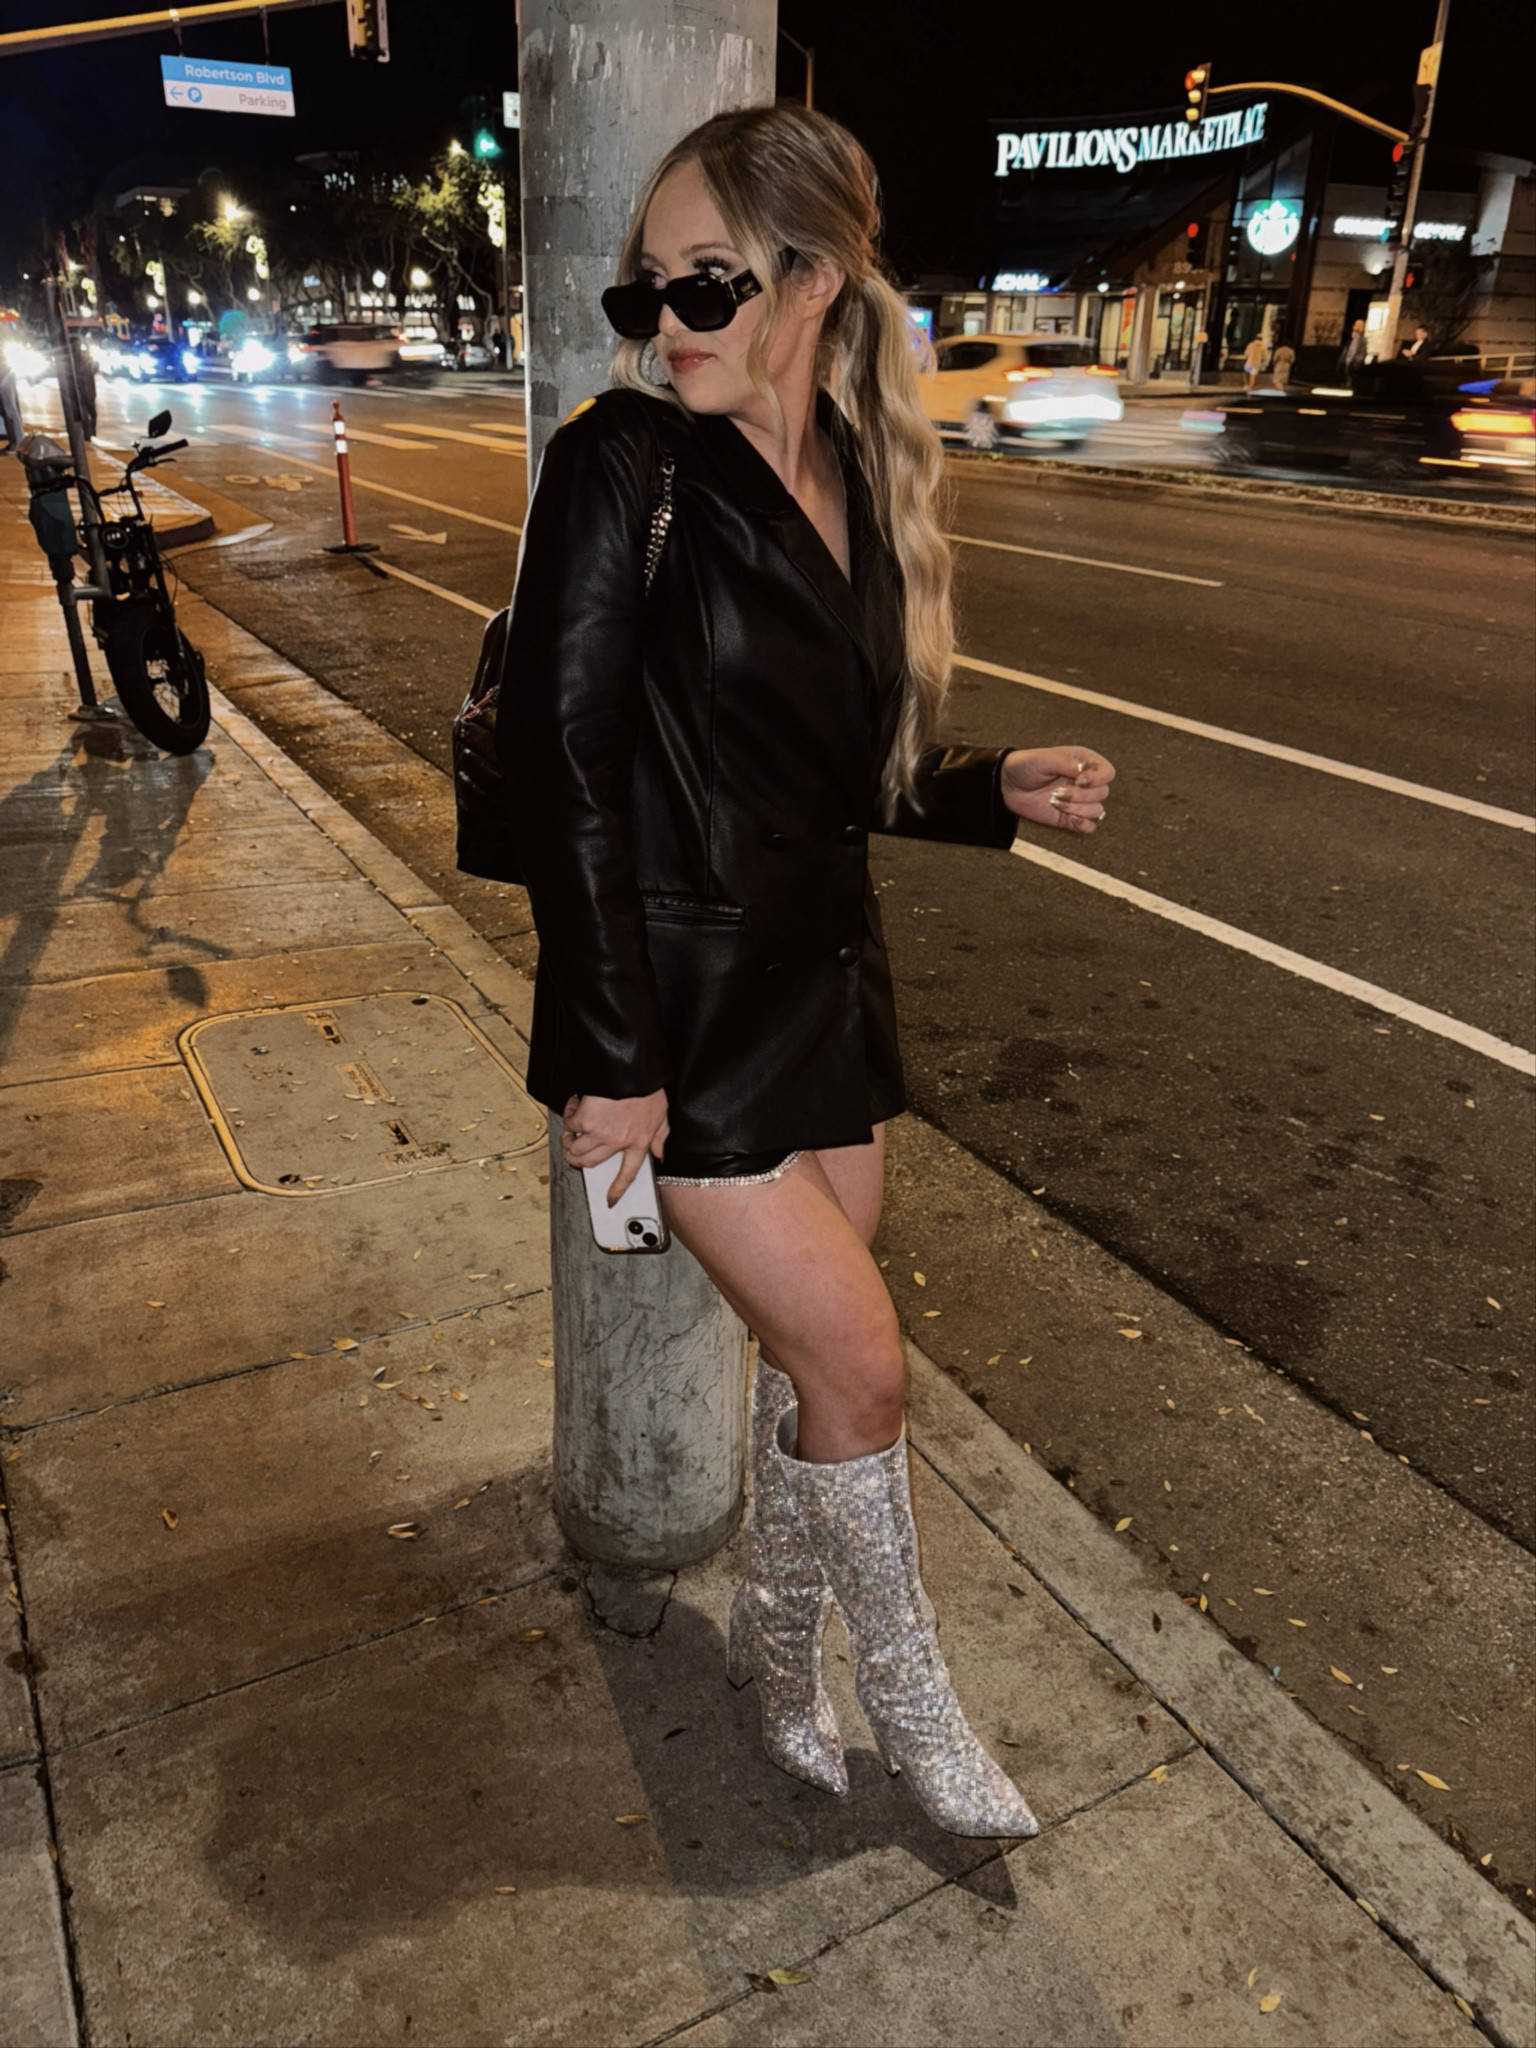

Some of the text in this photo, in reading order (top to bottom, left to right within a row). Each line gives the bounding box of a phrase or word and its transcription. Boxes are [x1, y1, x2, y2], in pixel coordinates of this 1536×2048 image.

[184, 64, 285, 85] Robertson Blvd
[239, 93, 287, 110] Parking
[994, 128, 1138, 176] PAVILIONS
